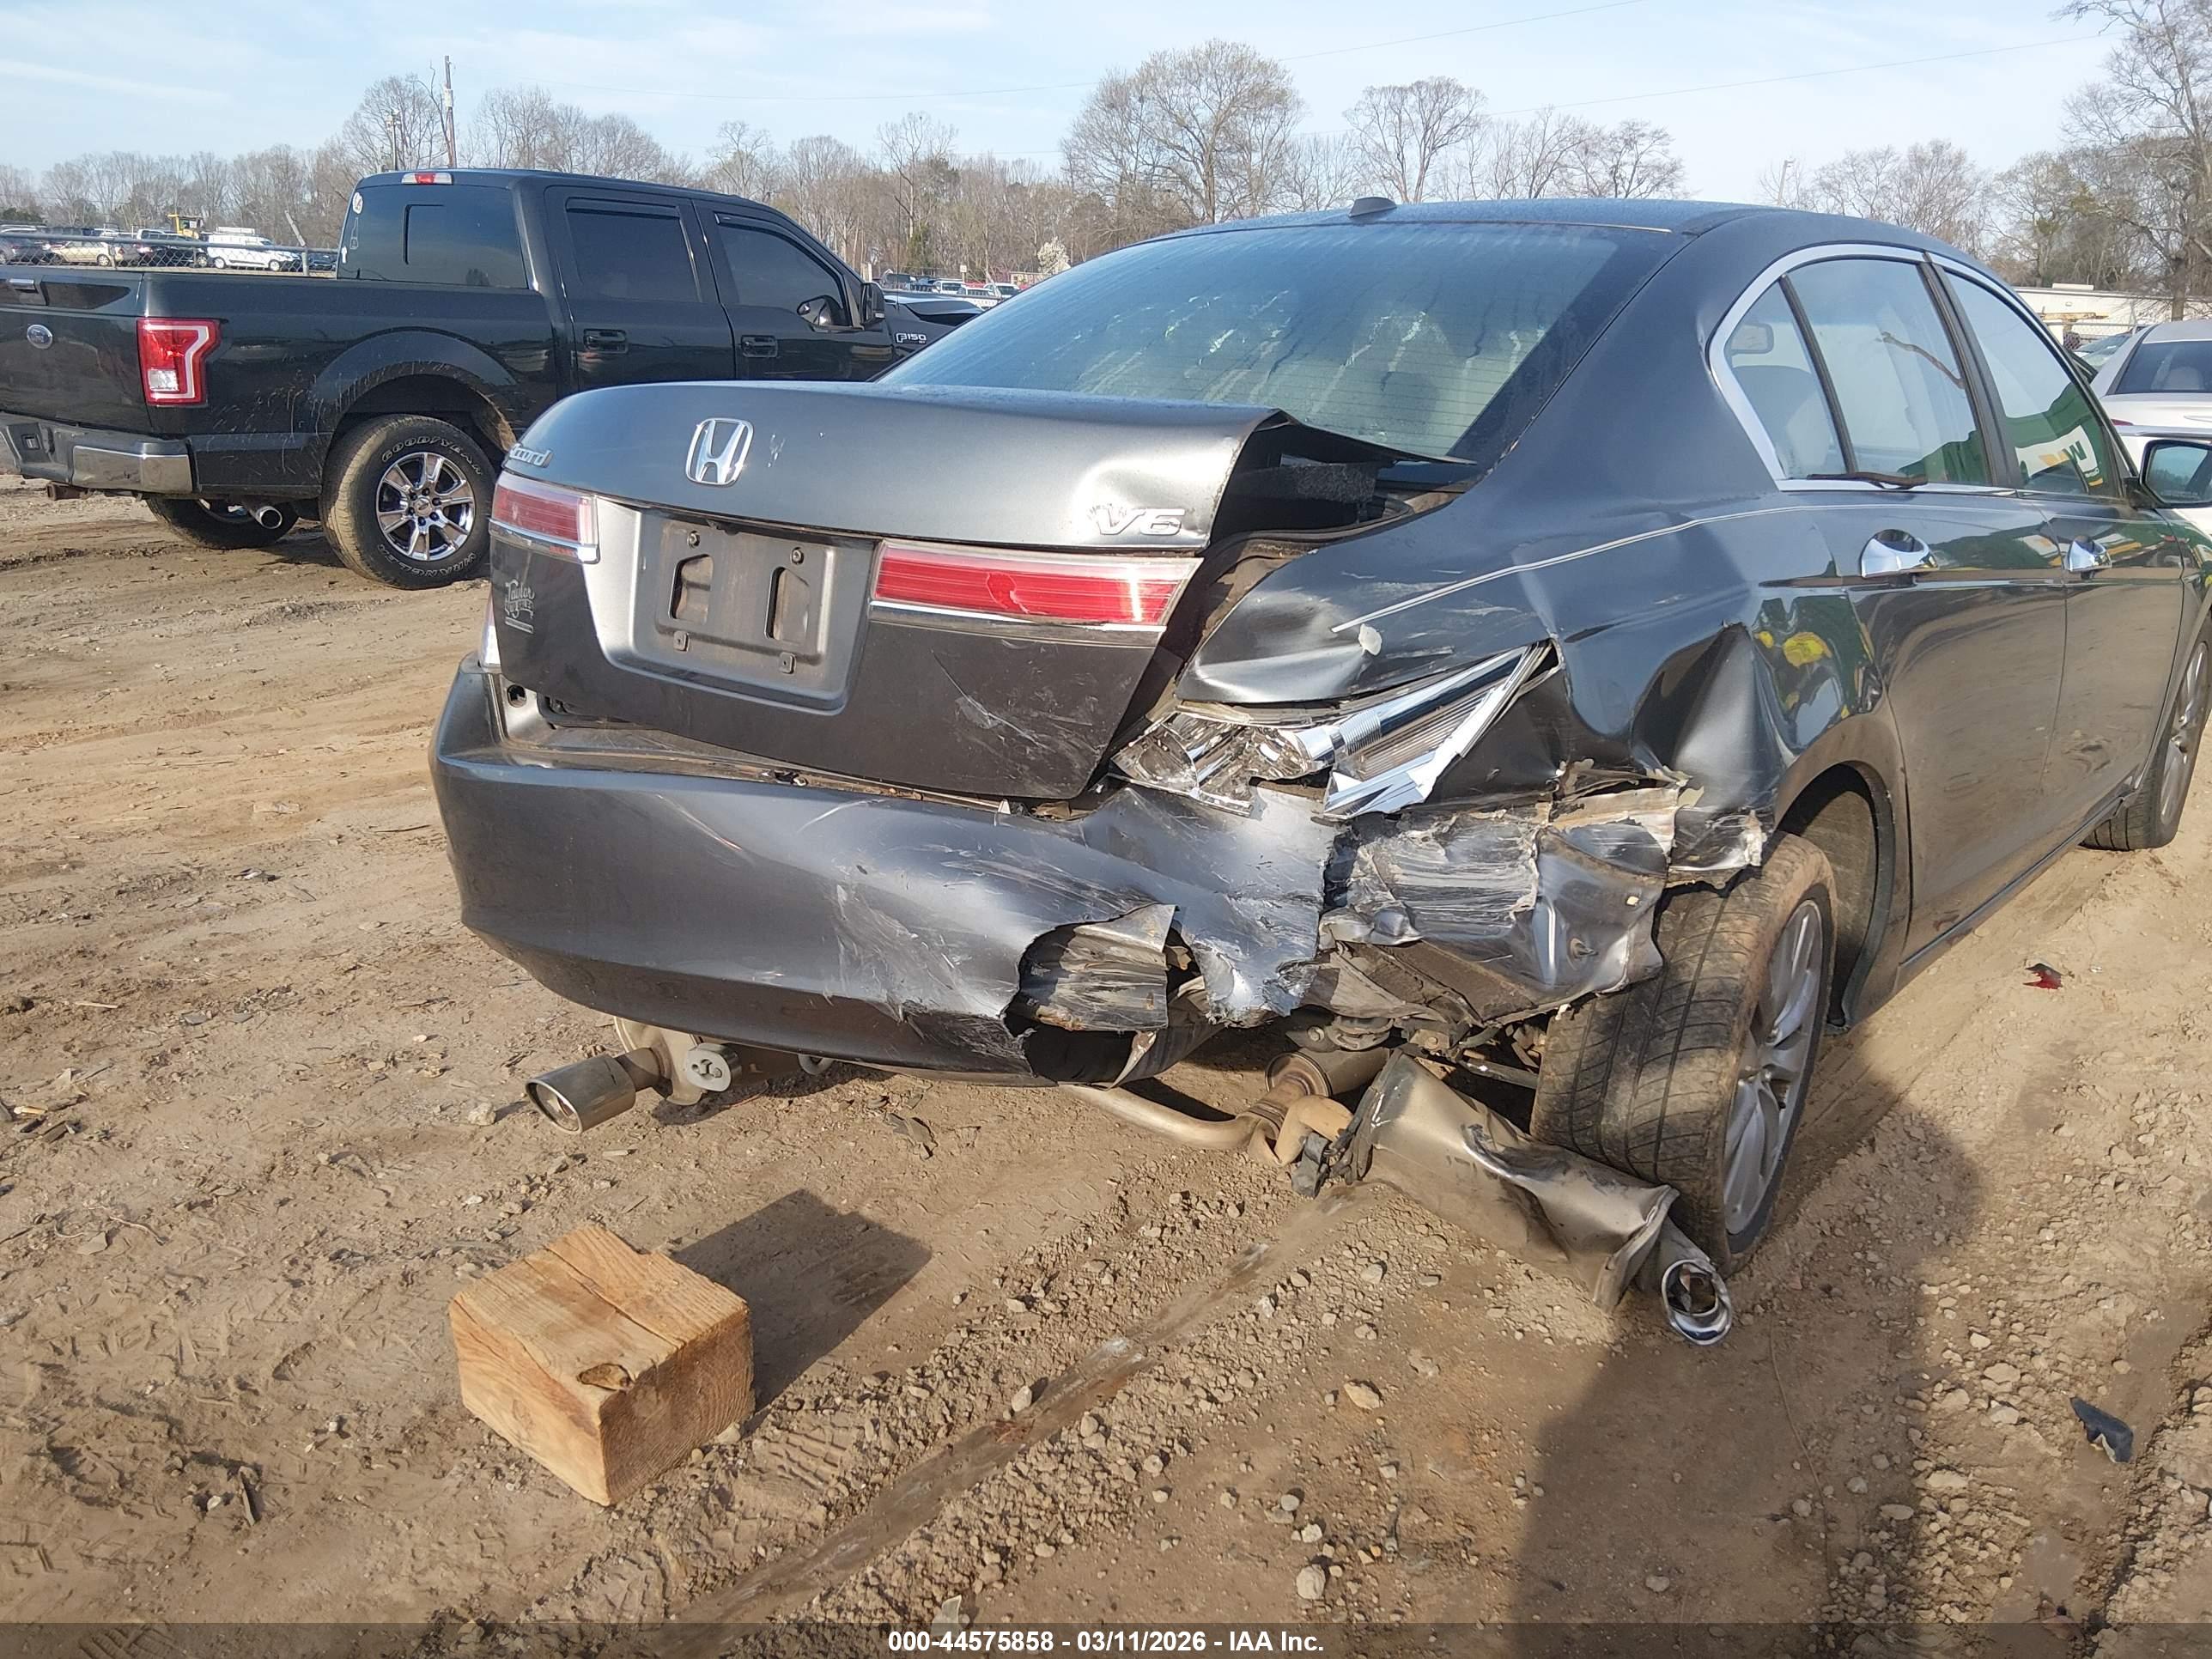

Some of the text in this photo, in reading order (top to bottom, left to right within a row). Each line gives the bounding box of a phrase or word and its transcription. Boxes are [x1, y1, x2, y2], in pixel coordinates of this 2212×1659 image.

[381, 435, 483, 475] GOODYEAR
[1095, 507, 1186, 537] V6
[377, 543, 477, 578] WRANGLER
